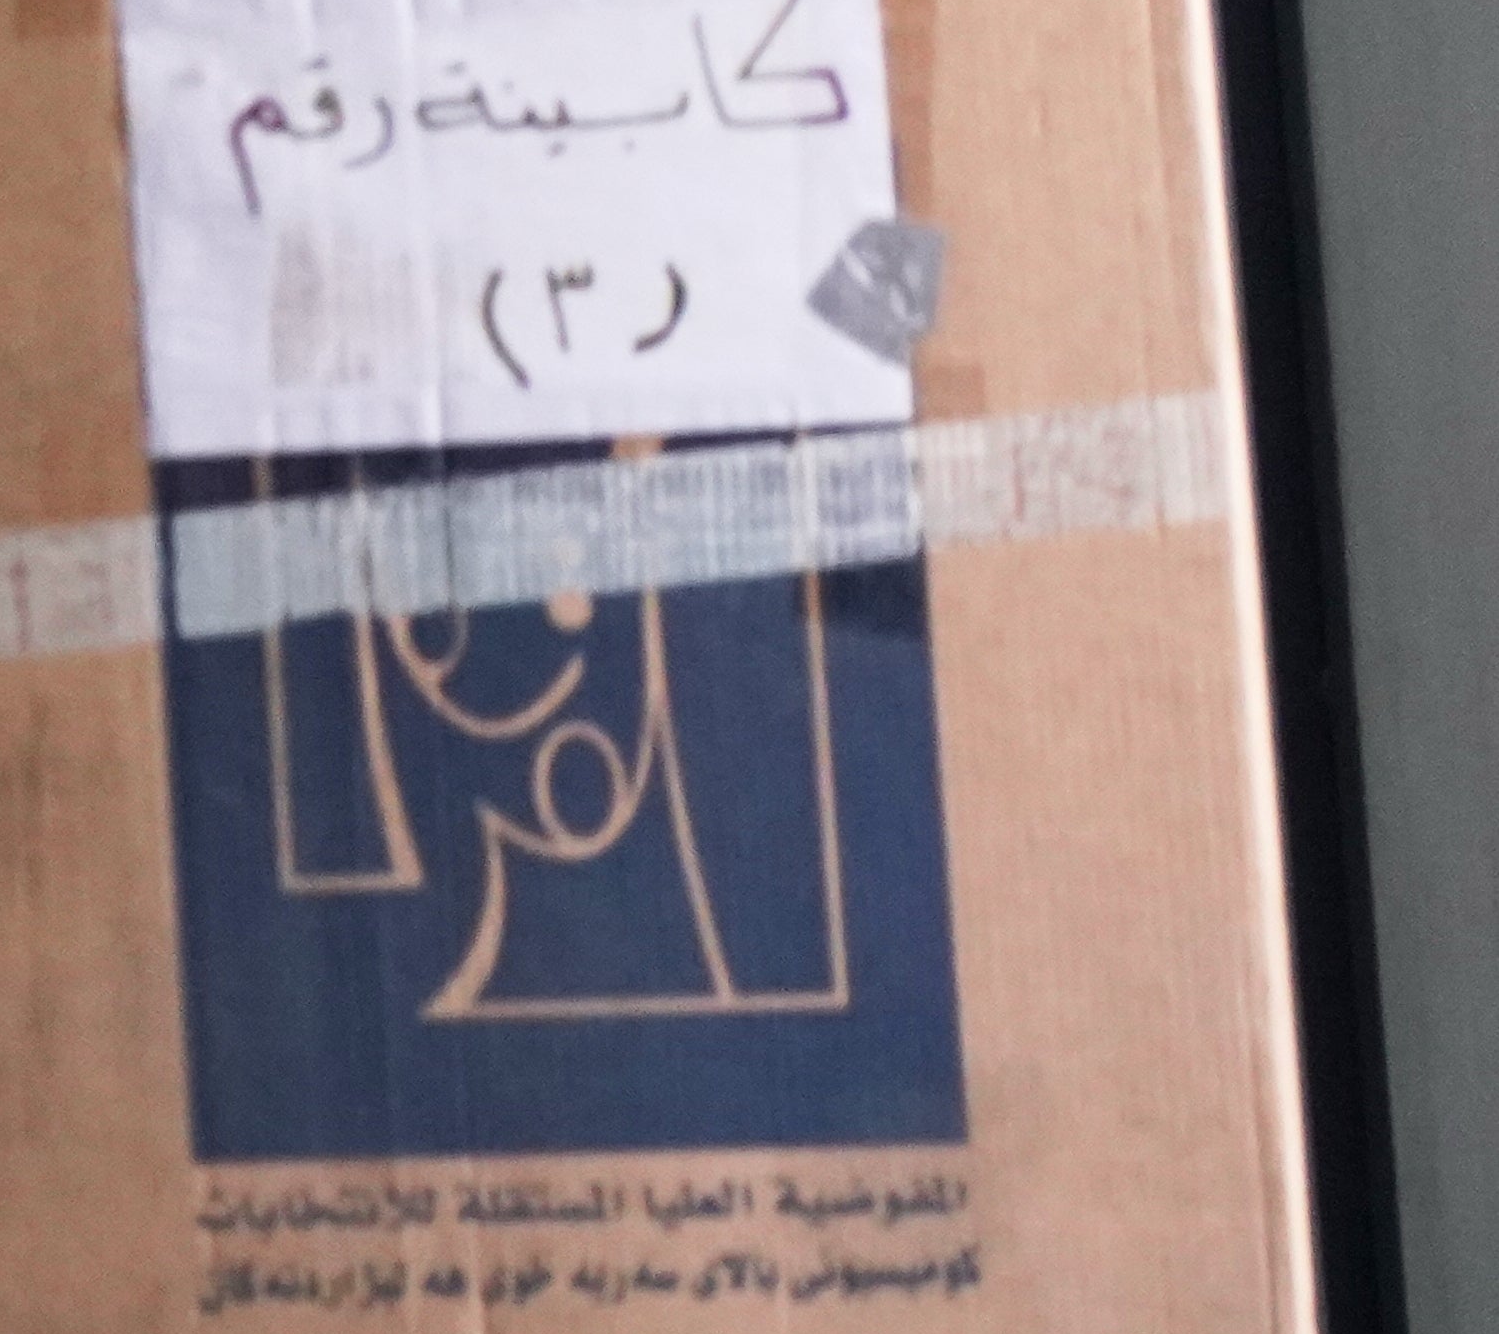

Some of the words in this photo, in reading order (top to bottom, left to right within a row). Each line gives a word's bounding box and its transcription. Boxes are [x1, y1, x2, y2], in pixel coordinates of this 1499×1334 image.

[227, 55, 397, 220] رقم
[456, 1179, 625, 1228] المستقلة
[643, 1177, 752, 1233] العليا
[773, 1172, 968, 1227] المفوضية
